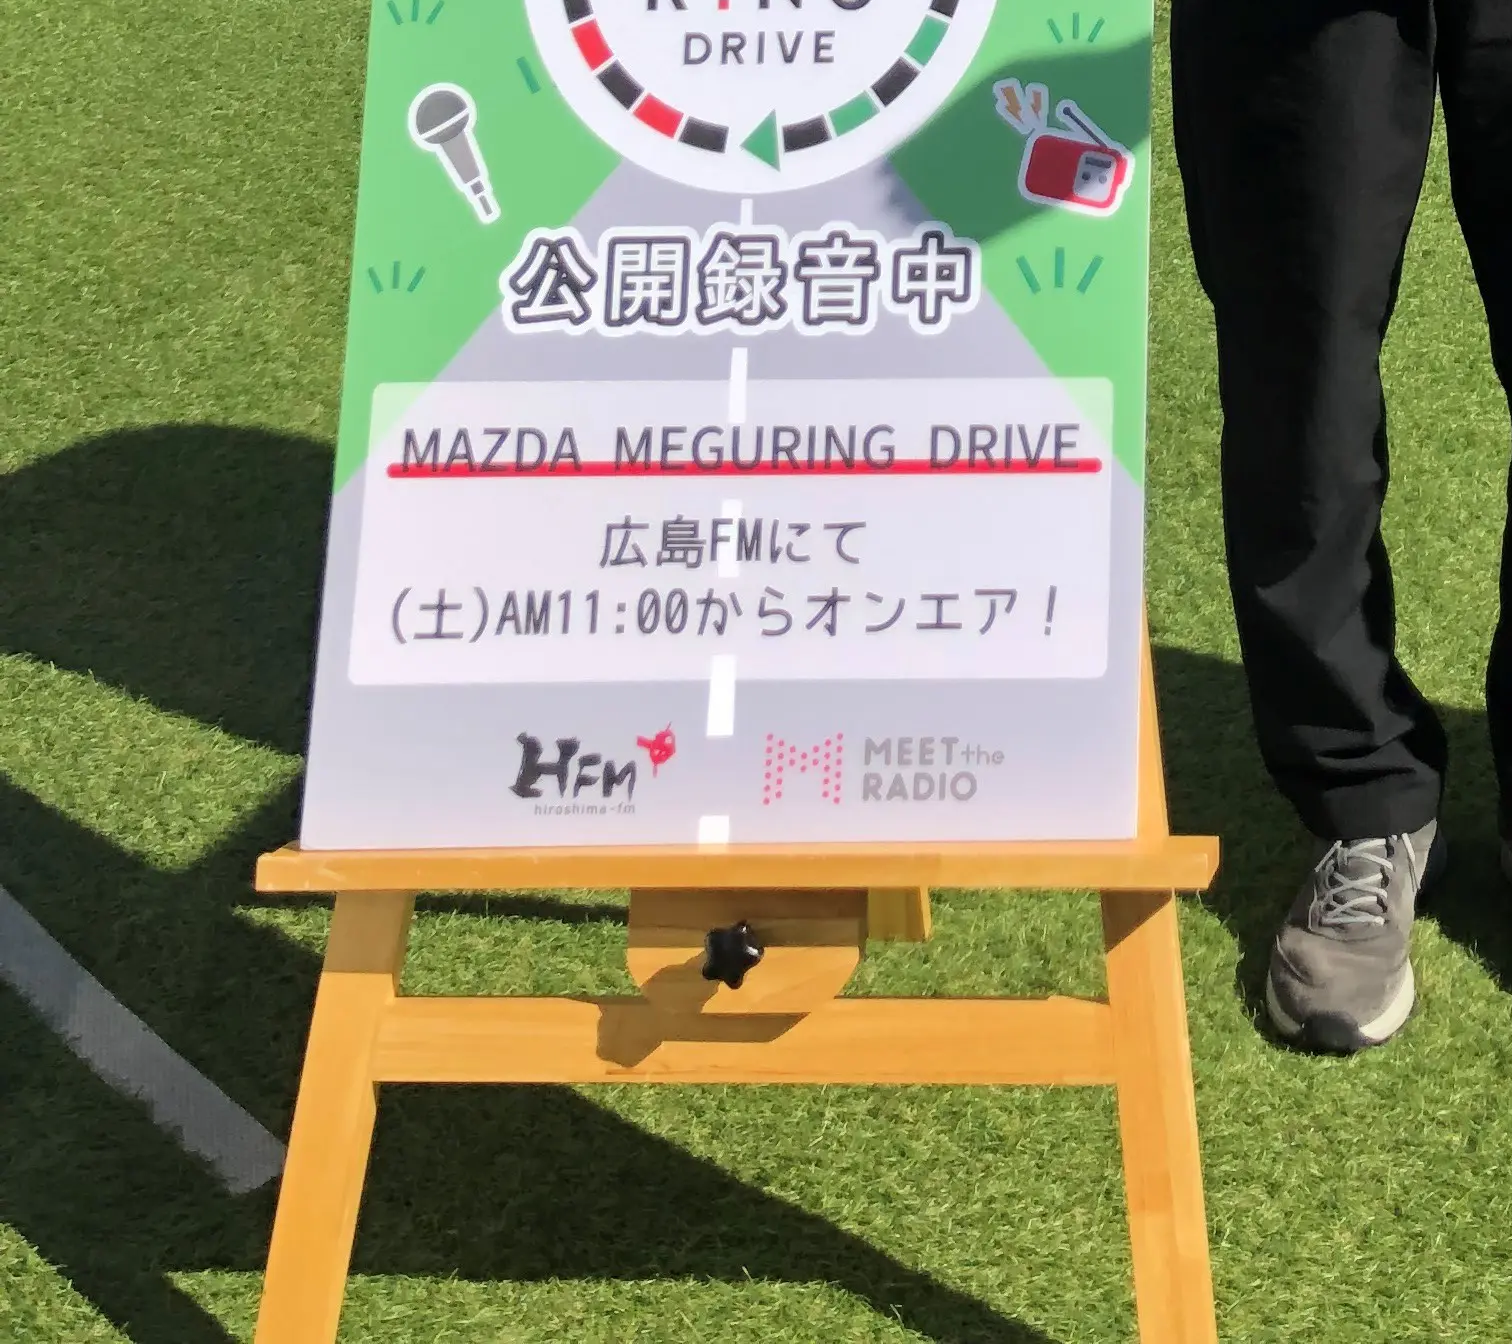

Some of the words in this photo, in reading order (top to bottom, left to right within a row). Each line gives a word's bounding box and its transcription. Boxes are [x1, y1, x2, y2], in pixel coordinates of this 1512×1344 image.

[683, 30, 836, 66] DRIVE
[507, 228, 974, 327] 公開録音中
[402, 426, 583, 472] MAZDA
[613, 423, 896, 471] MEGURING
[930, 422, 1080, 469] DRIVE
[599, 514, 867, 569] 広島FMにて
[508, 732, 637, 801] HFM
[862, 770, 978, 802] RADIO
